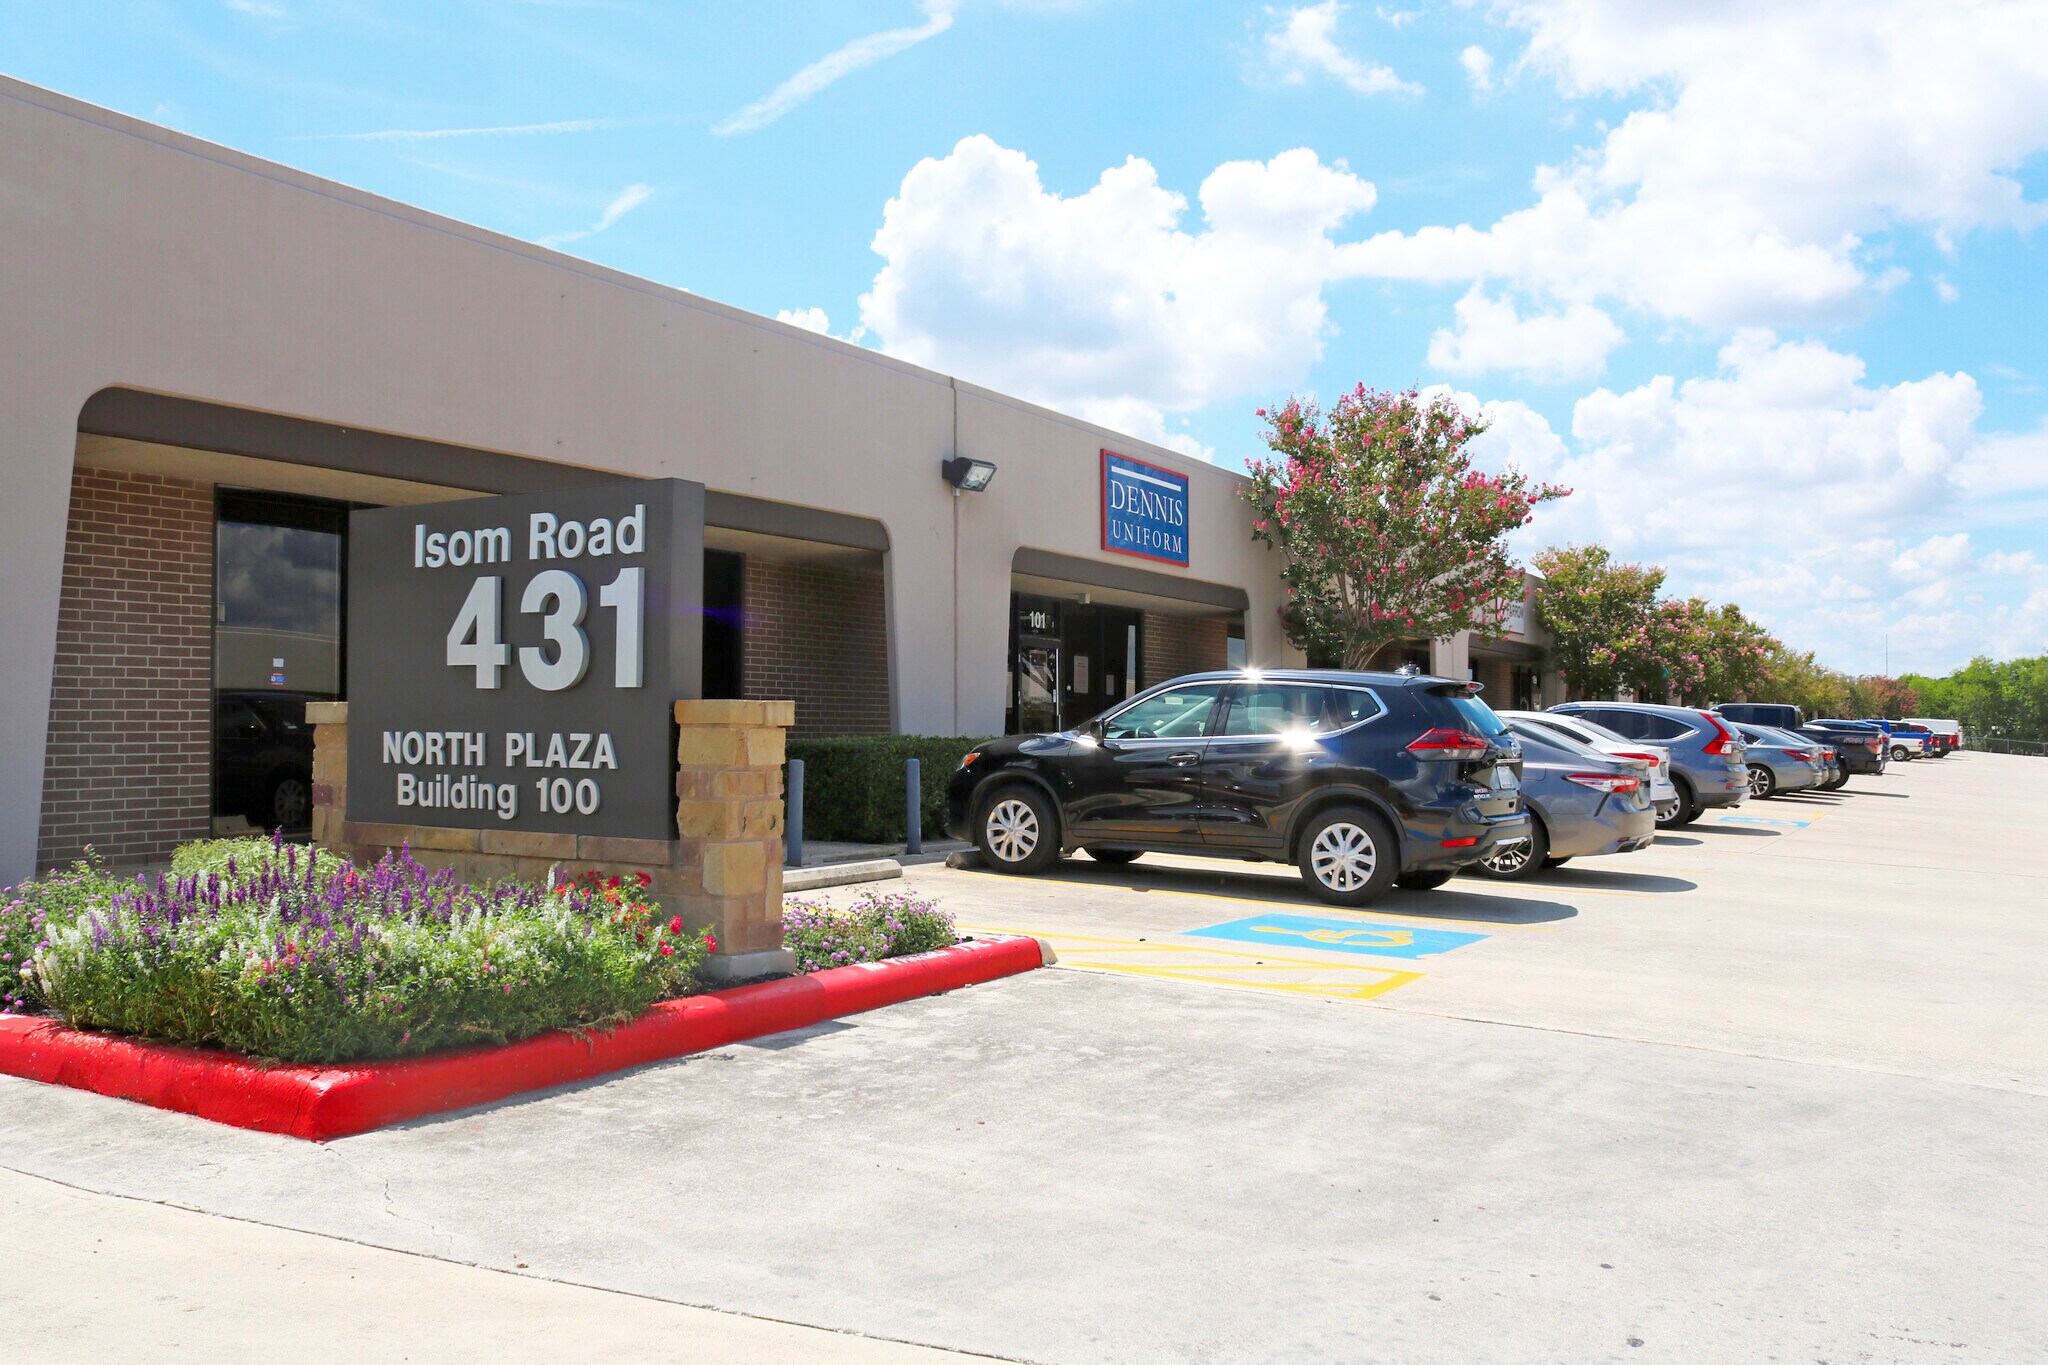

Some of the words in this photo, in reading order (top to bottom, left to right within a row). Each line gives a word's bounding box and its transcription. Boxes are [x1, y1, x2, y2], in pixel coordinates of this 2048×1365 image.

[1111, 480, 1183, 526] DENNIS
[415, 524, 511, 567] Isom
[529, 504, 646, 560] Road
[1113, 520, 1182, 553] UNIFORM
[446, 566, 646, 692] 431
[1029, 610, 1046, 629] 101
[383, 731, 486, 766] NORTH
[505, 732, 619, 770] PLAZA
[397, 773, 518, 820] Building
[535, 777, 601, 816] 100
